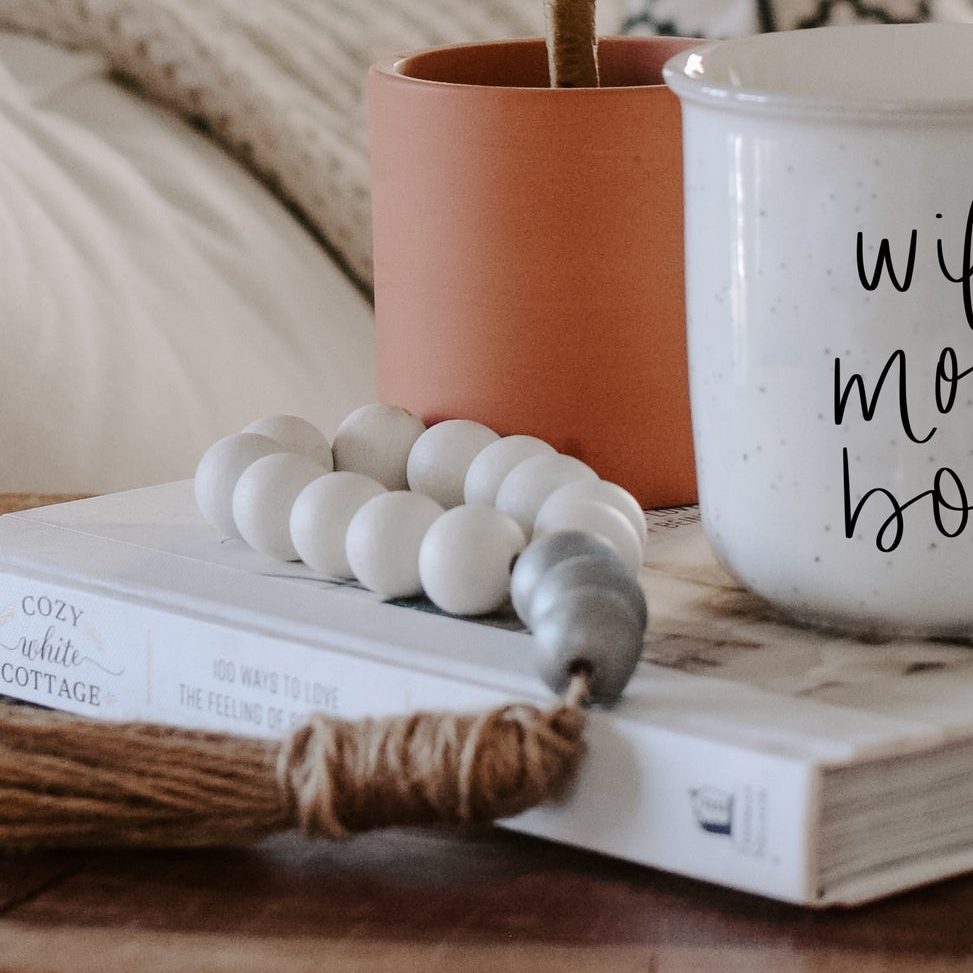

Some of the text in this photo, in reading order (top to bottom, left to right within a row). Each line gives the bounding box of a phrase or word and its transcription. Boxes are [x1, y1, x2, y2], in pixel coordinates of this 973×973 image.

[22, 595, 84, 627] COZY
[1, 662, 101, 707] COTTAGE
[179, 683, 203, 711] THE
[207, 690, 264, 726] FEELING
[267, 705, 284, 729] OF
[213, 658, 339, 711] 100 WAYS TO LOVE
